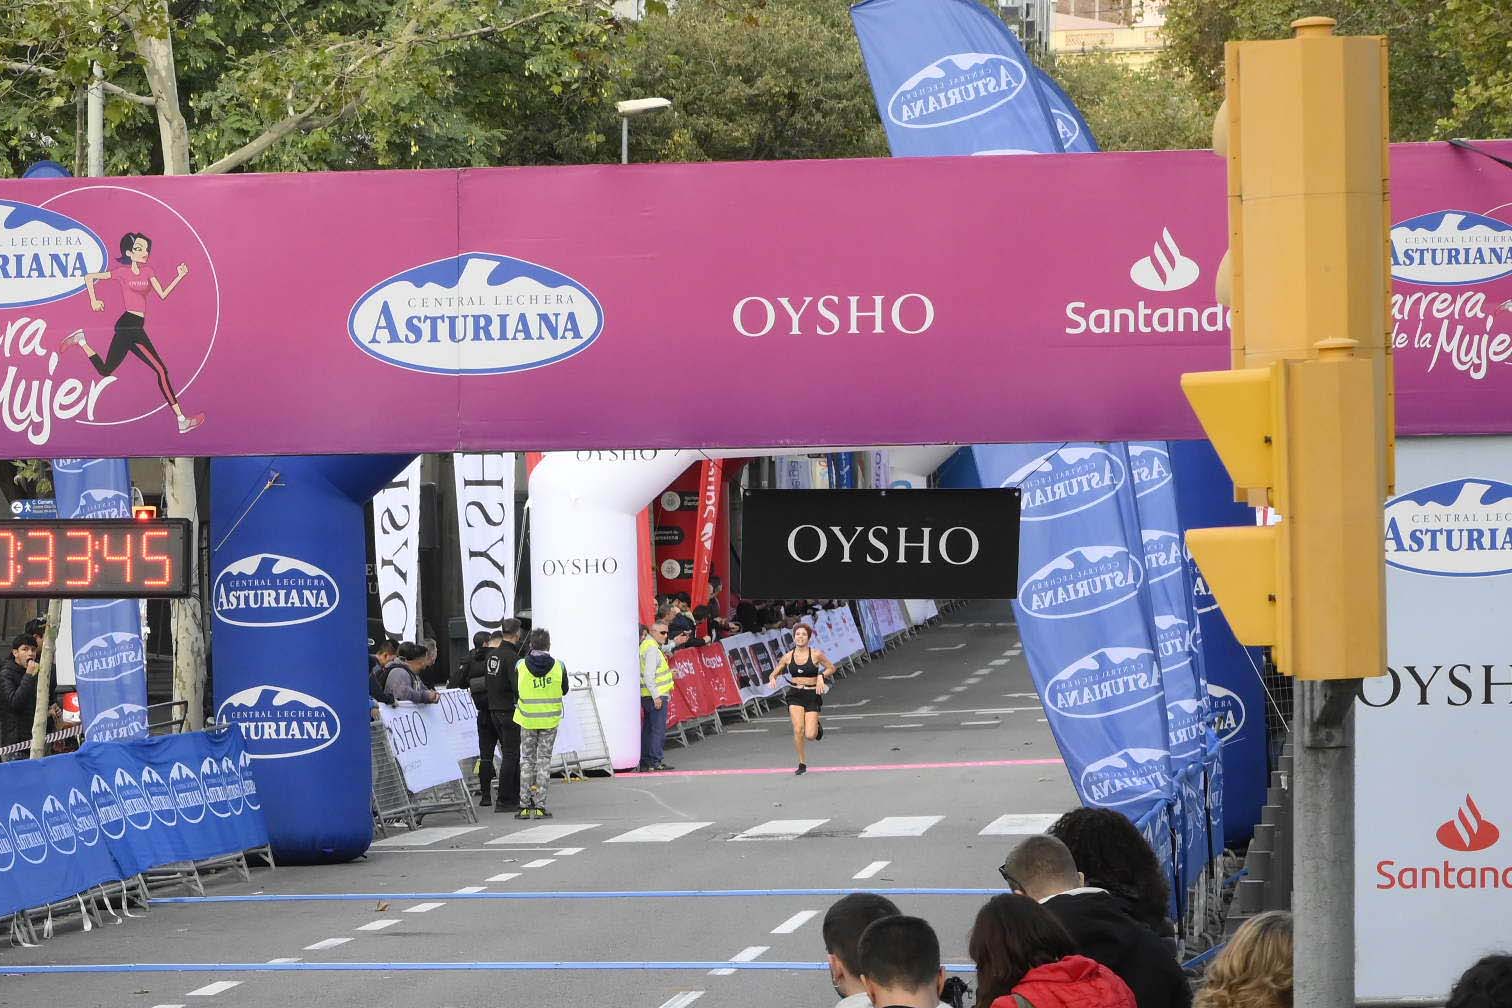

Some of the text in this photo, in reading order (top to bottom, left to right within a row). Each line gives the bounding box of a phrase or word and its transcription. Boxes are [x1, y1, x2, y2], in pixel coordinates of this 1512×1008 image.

[11, 236, 83, 247] LECHERA
[1405, 235, 1457, 245] CENTRAL
[408, 293, 576, 309] CENTRAL LECHERA
[1391, 291, 1486, 320] arrera
[368, 300, 583, 345] ASTURIANA
[732, 293, 935, 338] OYSHO
[1065, 301, 1231, 334] Santand
[1414, 321, 1433, 349] la
[1427, 315, 1512, 380] Muje
[1412, 513, 1478, 523] CENTRAL
[787, 524, 980, 567] OYSHO
[1384, 516, 1512, 553] ASTURIA
[542, 556, 619, 577] OYSHO
[217, 583, 330, 611] ASTURIANA
[230, 579, 326, 588] CENTRAL LECHERA
[1356, 664, 1512, 708] OYSH
[222, 714, 331, 740] TURIANA
[231, 710, 326, 718] CENTRAL LECHERA
[1376, 860, 1512, 890] Santan
